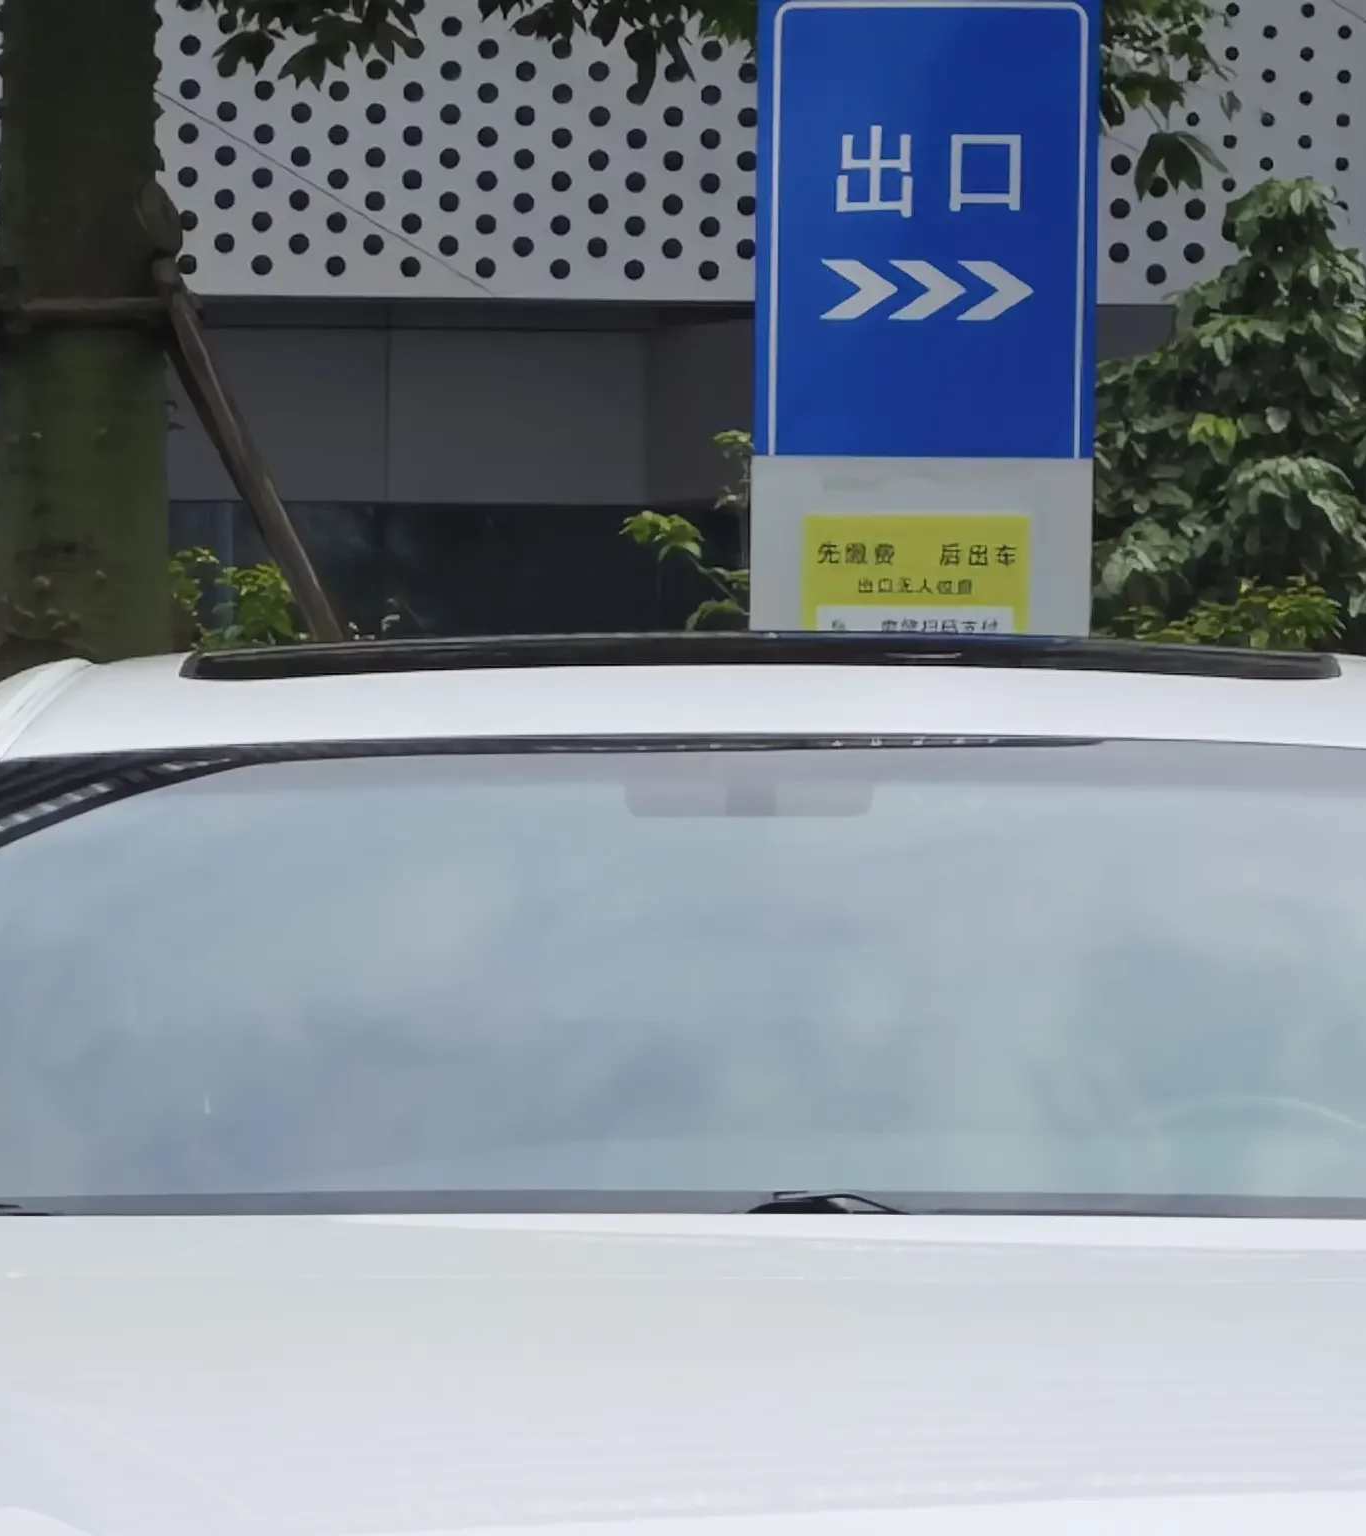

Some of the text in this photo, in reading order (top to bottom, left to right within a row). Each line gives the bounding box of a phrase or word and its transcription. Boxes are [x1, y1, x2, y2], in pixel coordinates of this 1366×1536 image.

[835, 125, 1022, 218] 出口
[939, 542, 1017, 567] 后出车
